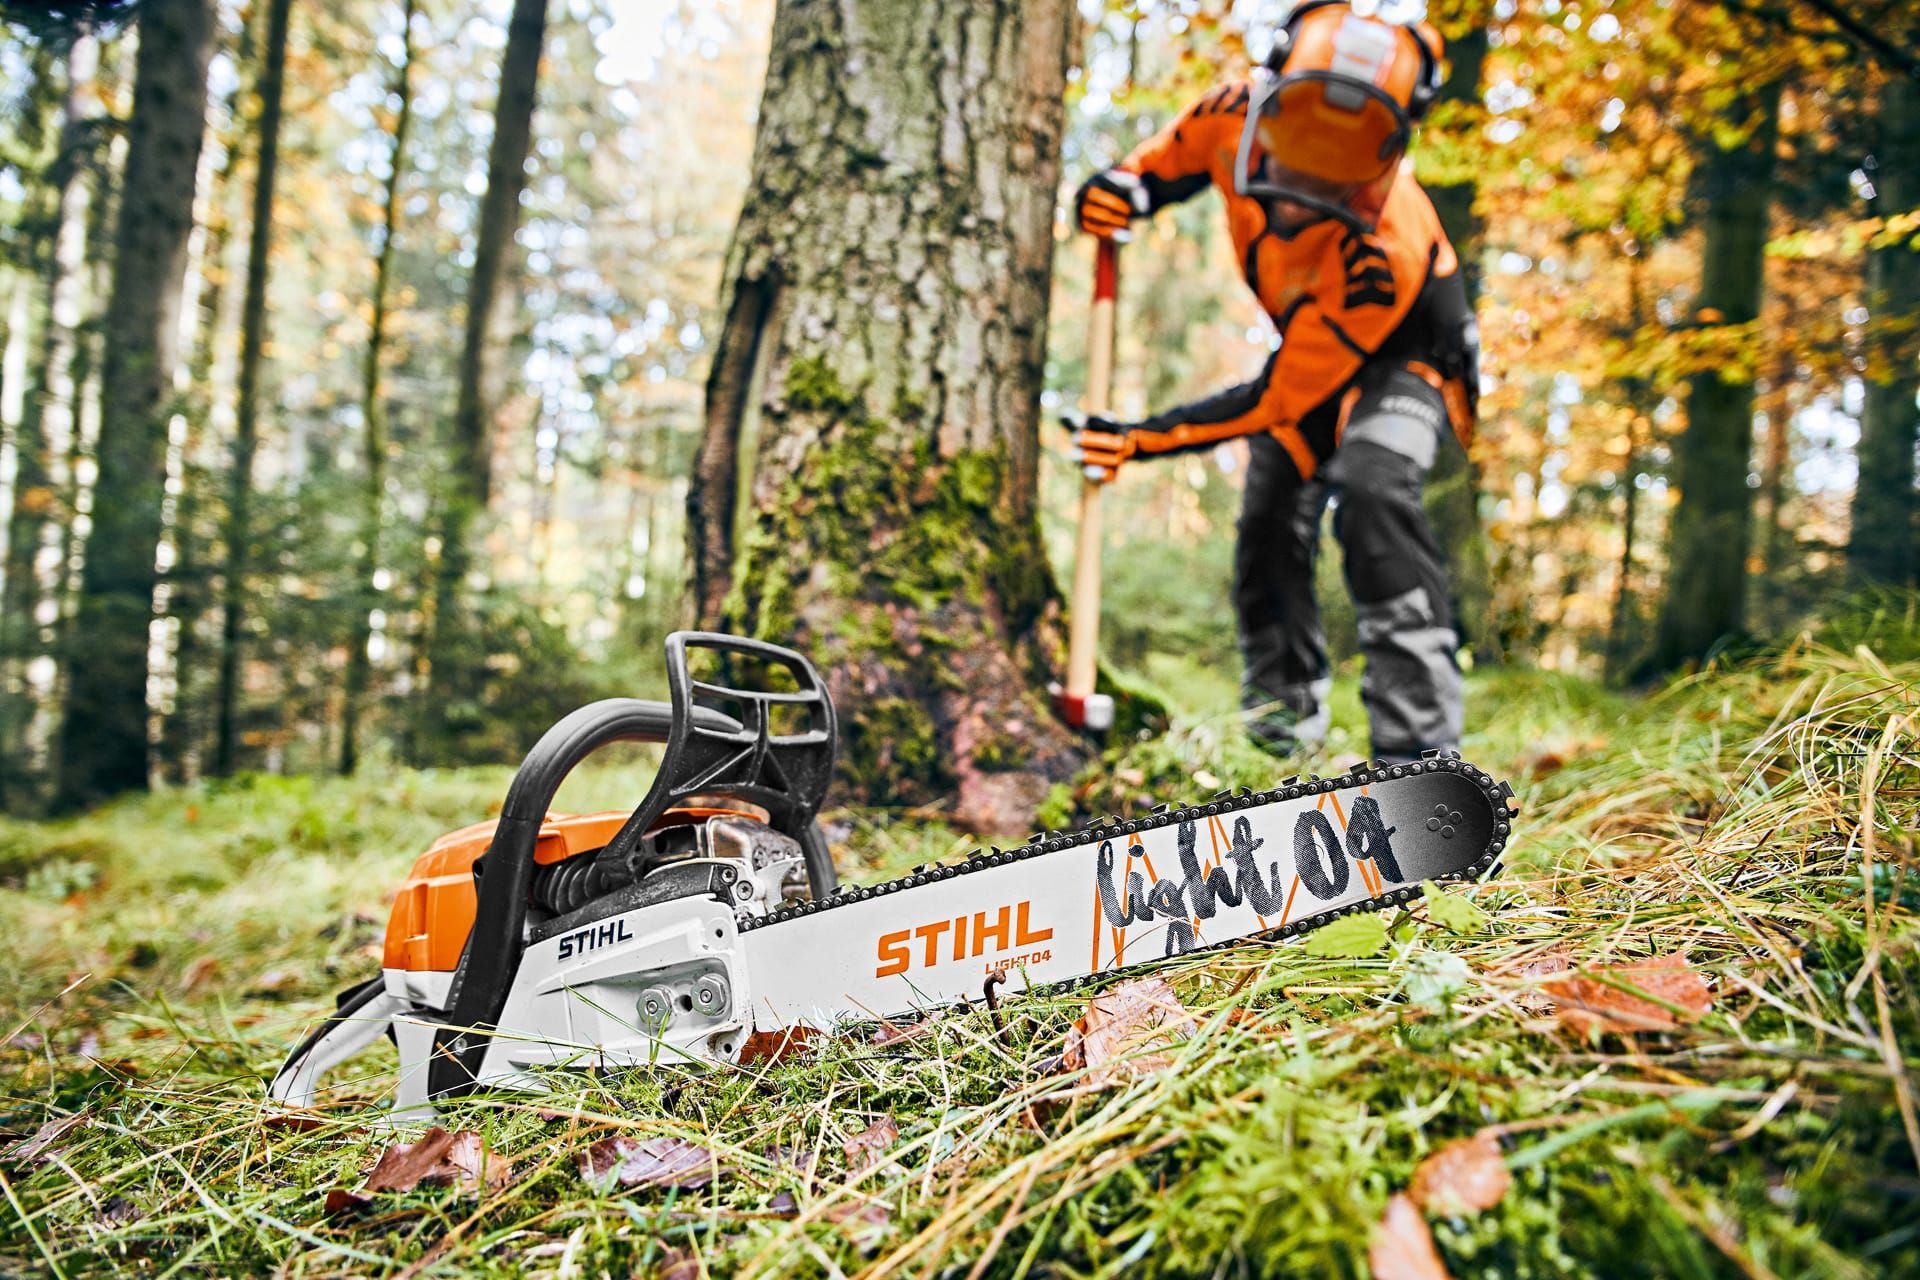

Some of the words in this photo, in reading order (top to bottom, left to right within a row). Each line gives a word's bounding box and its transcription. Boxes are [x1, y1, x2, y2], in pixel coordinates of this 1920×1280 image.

[1097, 815, 1283, 956] light
[1294, 796, 1404, 900] 04
[558, 919, 633, 960] STIHL
[875, 900, 1054, 979] STIHL
[985, 953, 1030, 975] LIGHT
[1032, 949, 1052, 965] 04
